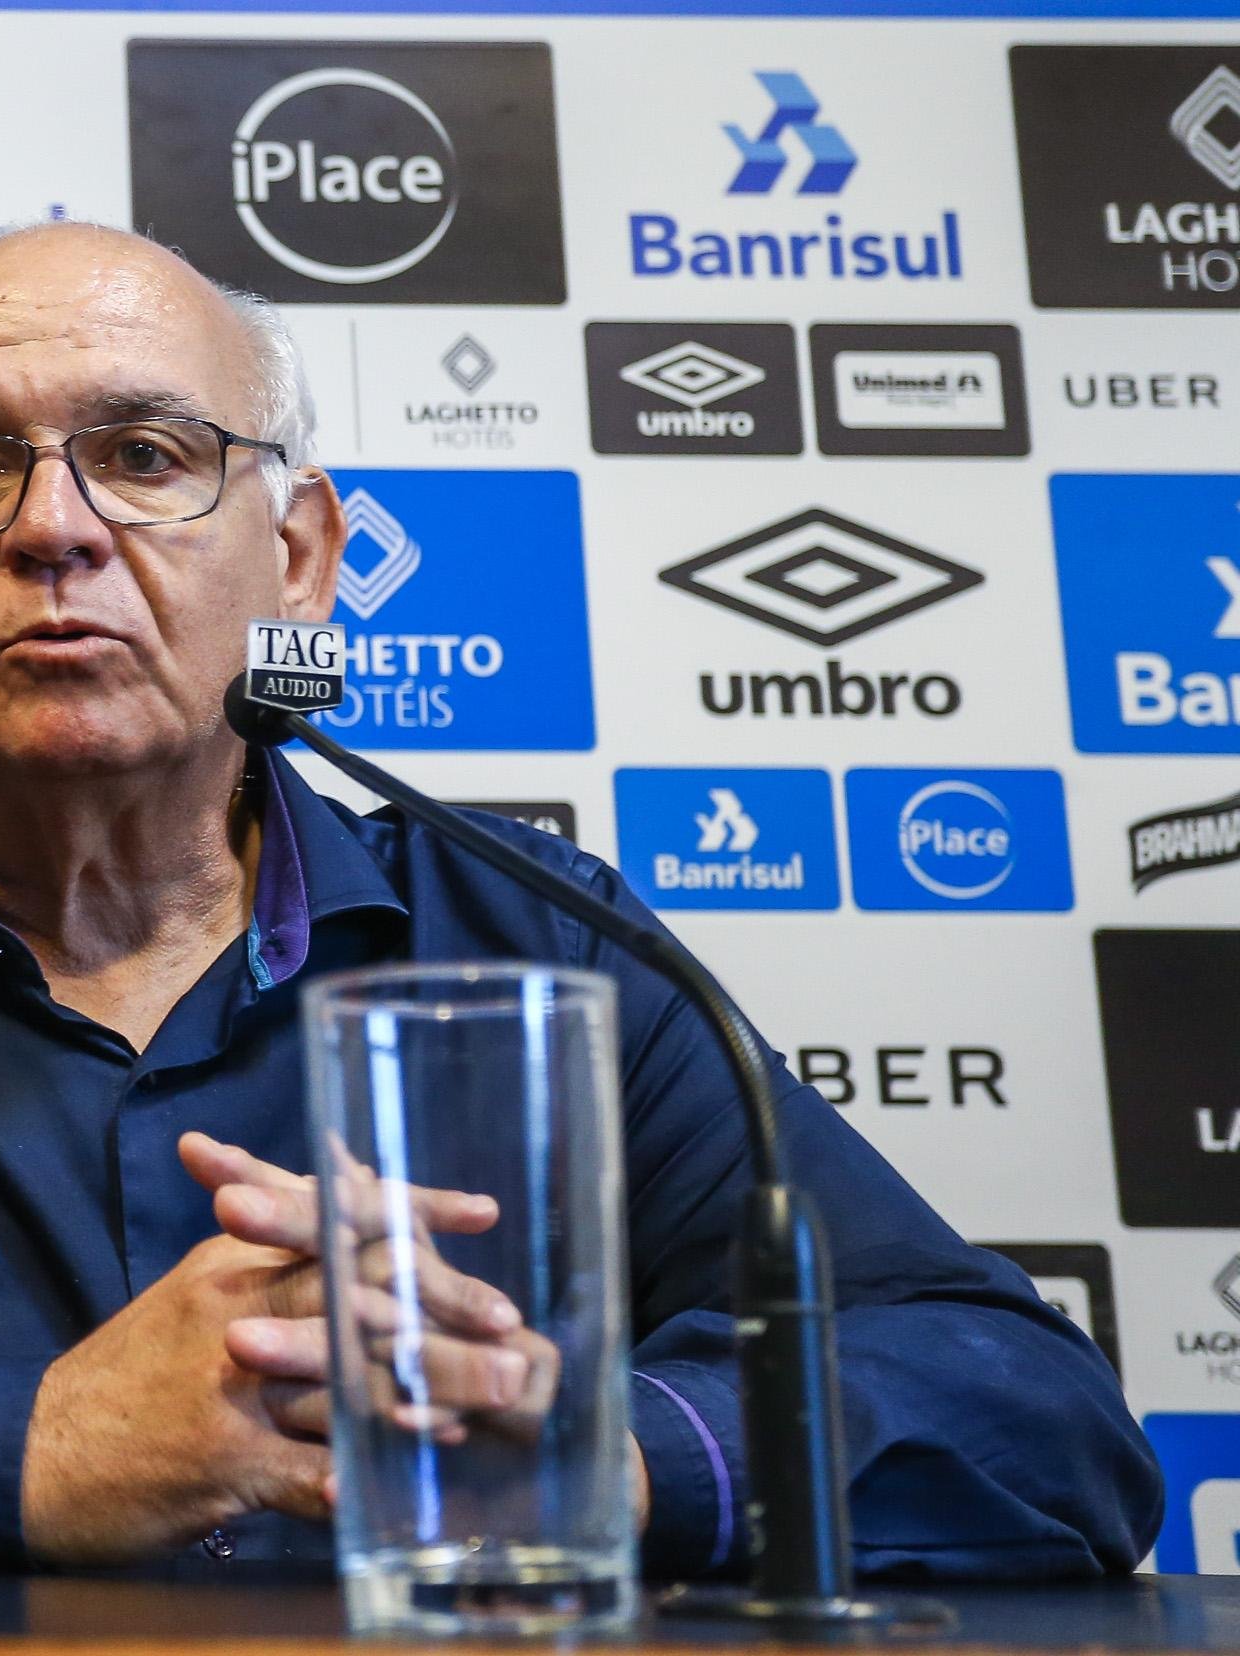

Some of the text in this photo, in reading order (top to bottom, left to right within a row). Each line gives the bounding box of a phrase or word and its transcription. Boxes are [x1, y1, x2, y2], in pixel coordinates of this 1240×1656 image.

[232, 139, 444, 204] iPlace
[629, 210, 962, 280] Banrisul
[1162, 249, 1240, 292] HO
[1063, 374, 1220, 408] UBER
[406, 403, 538, 424] LAGHETTO
[637, 405, 755, 437] umbro
[258, 626, 338, 669] TAG
[345, 633, 504, 678] HETTO
[263, 677, 331, 699] AUDIO
[312, 680, 454, 728] OTÉIS
[699, 660, 963, 717] umbro
[653, 851, 804, 890] Banrisul
[797, 1045, 1009, 1106] BER
